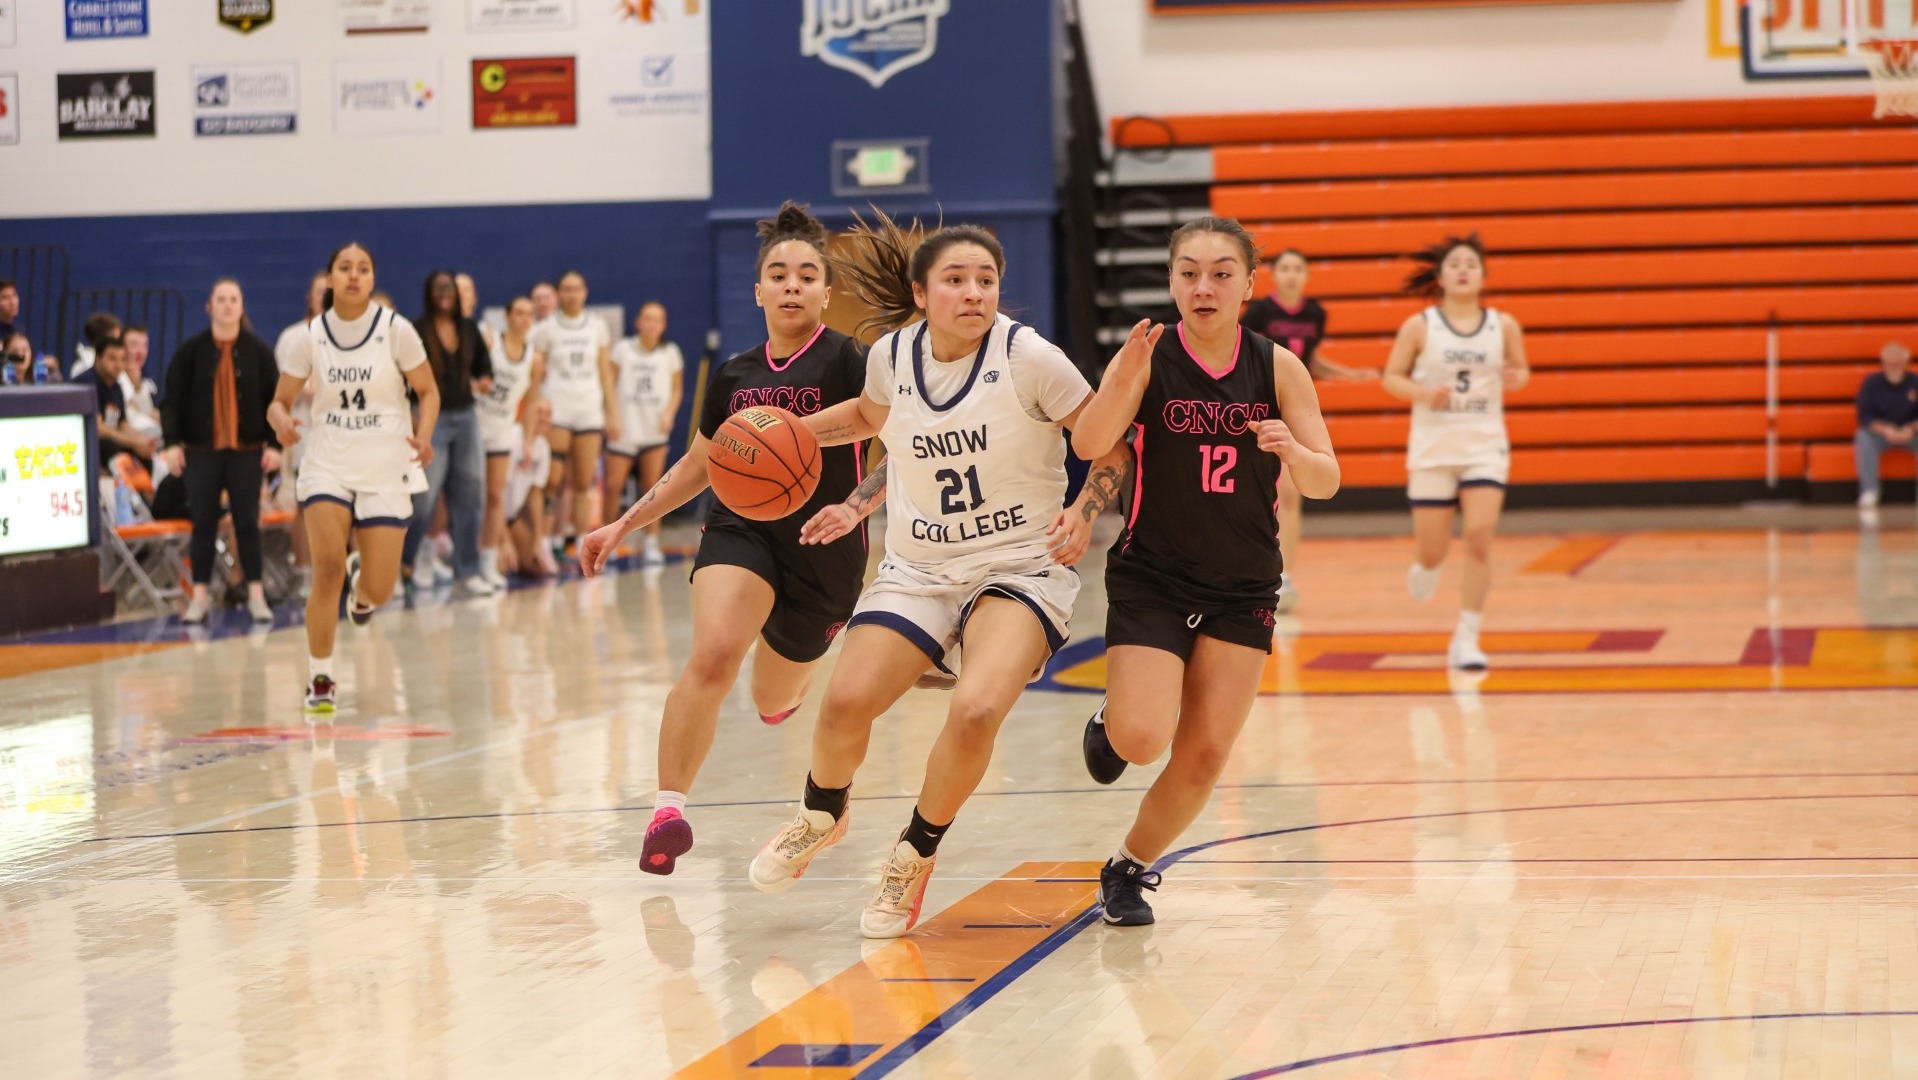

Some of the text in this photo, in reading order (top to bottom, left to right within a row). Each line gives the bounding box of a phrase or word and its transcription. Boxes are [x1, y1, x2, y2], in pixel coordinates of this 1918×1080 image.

[59, 94, 152, 124] BARCLAY
[328, 366, 373, 383] SNOW
[1455, 370, 1471, 394] 5
[339, 388, 366, 411] 14
[912, 424, 987, 459] SNOW
[1199, 444, 1238, 494] 12
[50, 488, 83, 518] 94.5
[934, 464, 986, 516] 21
[911, 503, 1027, 544] COLLEGE
